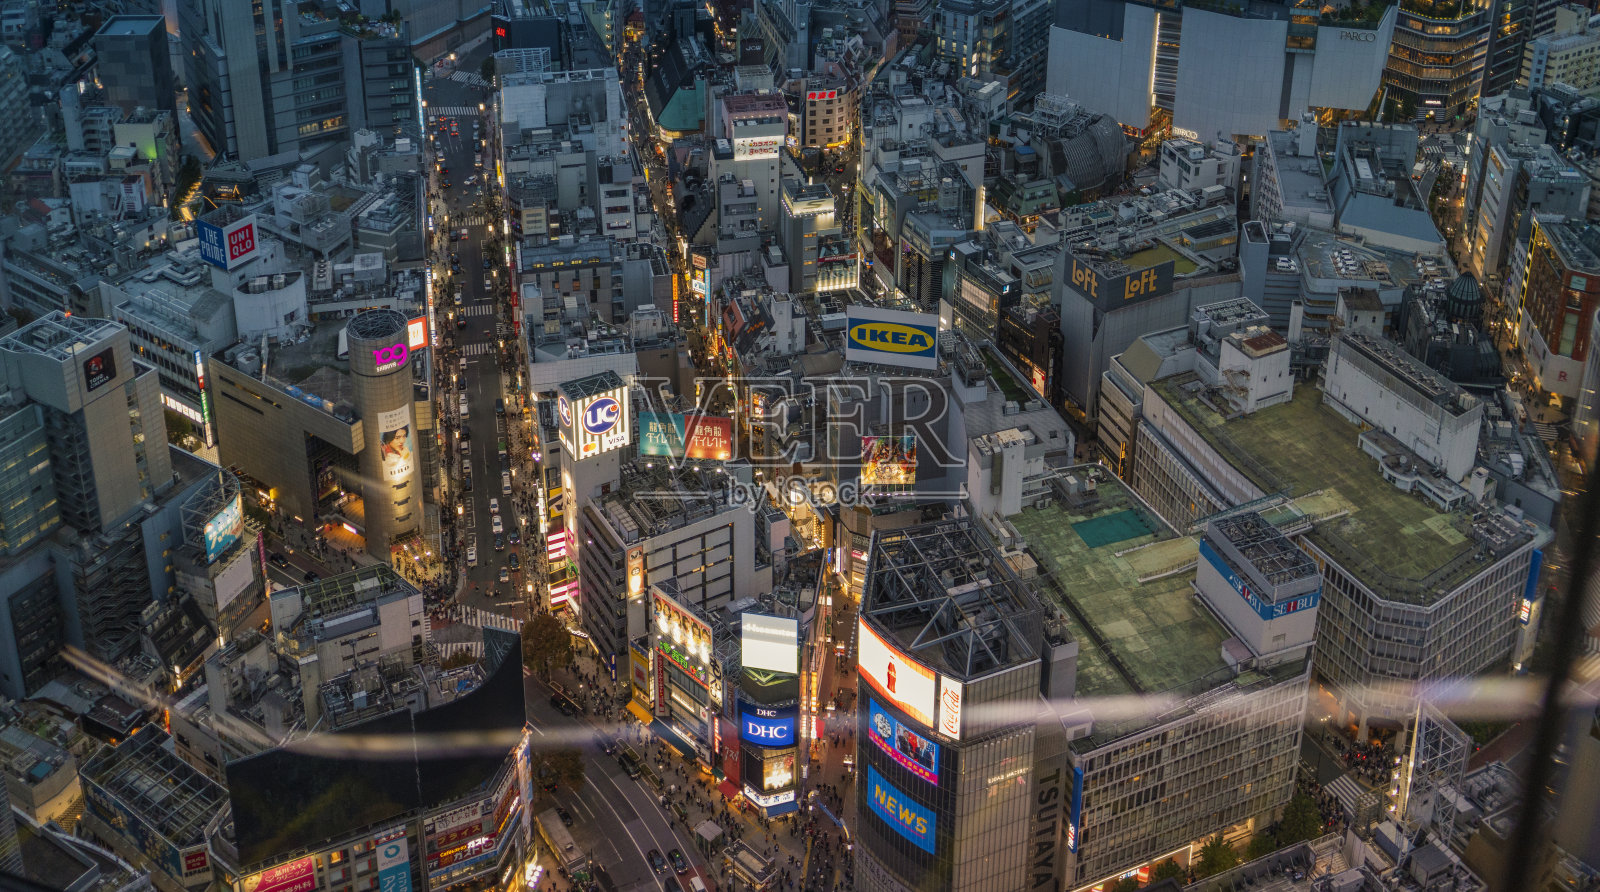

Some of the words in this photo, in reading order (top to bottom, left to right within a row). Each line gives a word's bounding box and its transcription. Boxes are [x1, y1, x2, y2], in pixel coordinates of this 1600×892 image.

[1340, 30, 1376, 42] PARCO
[203, 227, 219, 247] THE
[230, 228, 250, 245] UNI
[200, 240, 226, 264] PRIME
[232, 239, 253, 257] QLO
[857, 328, 929, 348] IKEA
[372, 343, 408, 367] 109
[586, 404, 619, 428] UC
[608, 436, 625, 445] VISA
[1273, 596, 1316, 617] SEIBU
[757, 708, 778, 718] DHC
[748, 721, 788, 739] DHC
[875, 784, 928, 834] NEWS
[1032, 768, 1060, 889] TSUTAYA
